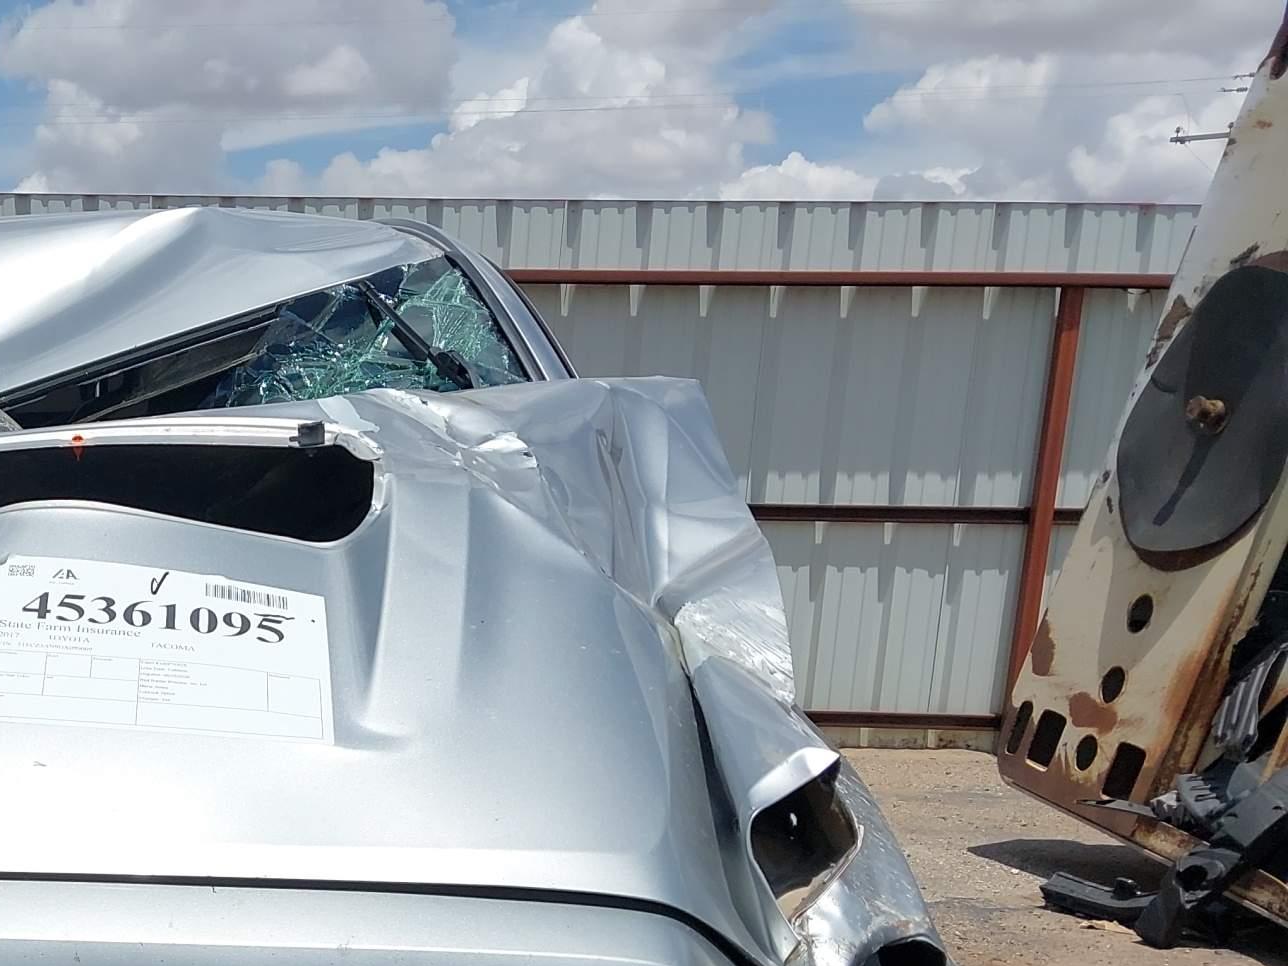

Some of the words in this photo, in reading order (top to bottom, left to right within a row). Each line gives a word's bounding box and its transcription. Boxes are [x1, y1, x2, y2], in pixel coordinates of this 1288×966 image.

[22, 592, 286, 643] 45361095
[37, 621, 72, 633] Farm
[76, 623, 142, 637] Insurance
[49, 634, 91, 643] TOYOTA
[151, 642, 196, 652] TACOMA
